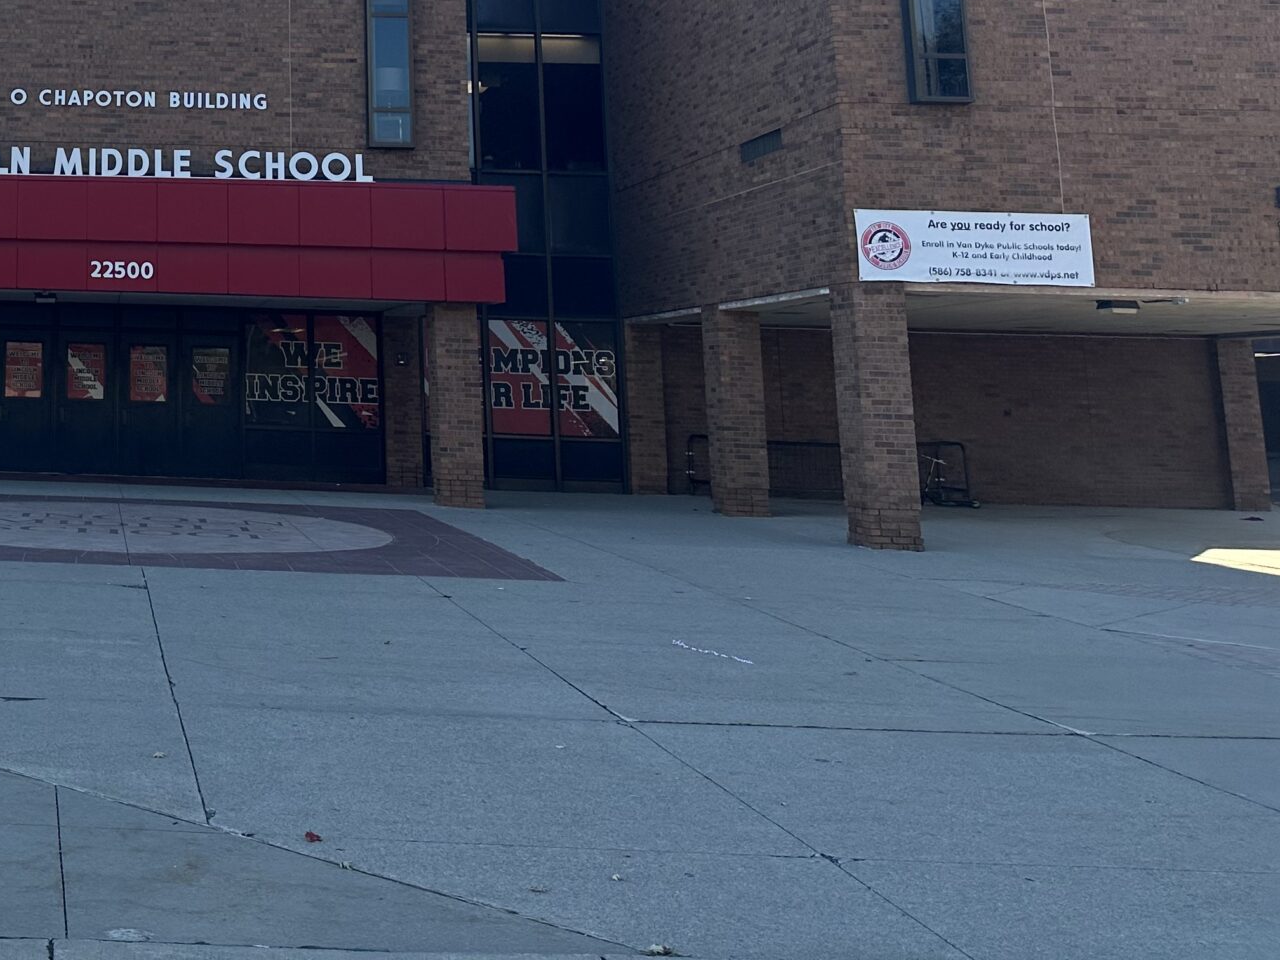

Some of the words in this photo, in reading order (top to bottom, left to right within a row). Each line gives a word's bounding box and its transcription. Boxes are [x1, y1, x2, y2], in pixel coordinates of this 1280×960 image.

[10, 88, 28, 106] O
[39, 88, 157, 109] CHAPOTON
[168, 91, 269, 111] BUILDING
[53, 147, 192, 178] MIDDLE
[213, 149, 375, 183] SCHOOL
[928, 219, 947, 229] Are
[950, 221, 971, 232] you
[974, 220, 1006, 233] ready
[1009, 220, 1026, 231] for
[1029, 222, 1071, 233] school?
[921, 240, 945, 248] Enroll
[956, 241, 973, 249] Van
[975, 241, 995, 250] Dyke
[1023, 243, 1054, 251] Schools
[1056, 244, 1082, 253] today!
[952, 251, 970, 259] K-12
[971, 251, 988, 259] and
[989, 252, 1010, 261] Early
[1011, 253, 1053, 261] Childhood
[90, 260, 155, 280] 22500
[928, 267, 952, 277] (586)
[279, 340, 343, 369] WE
[490, 347, 617, 378] MPIONS
[245, 373, 380, 405] INSPIRE
[521, 382, 592, 412] LIFE
